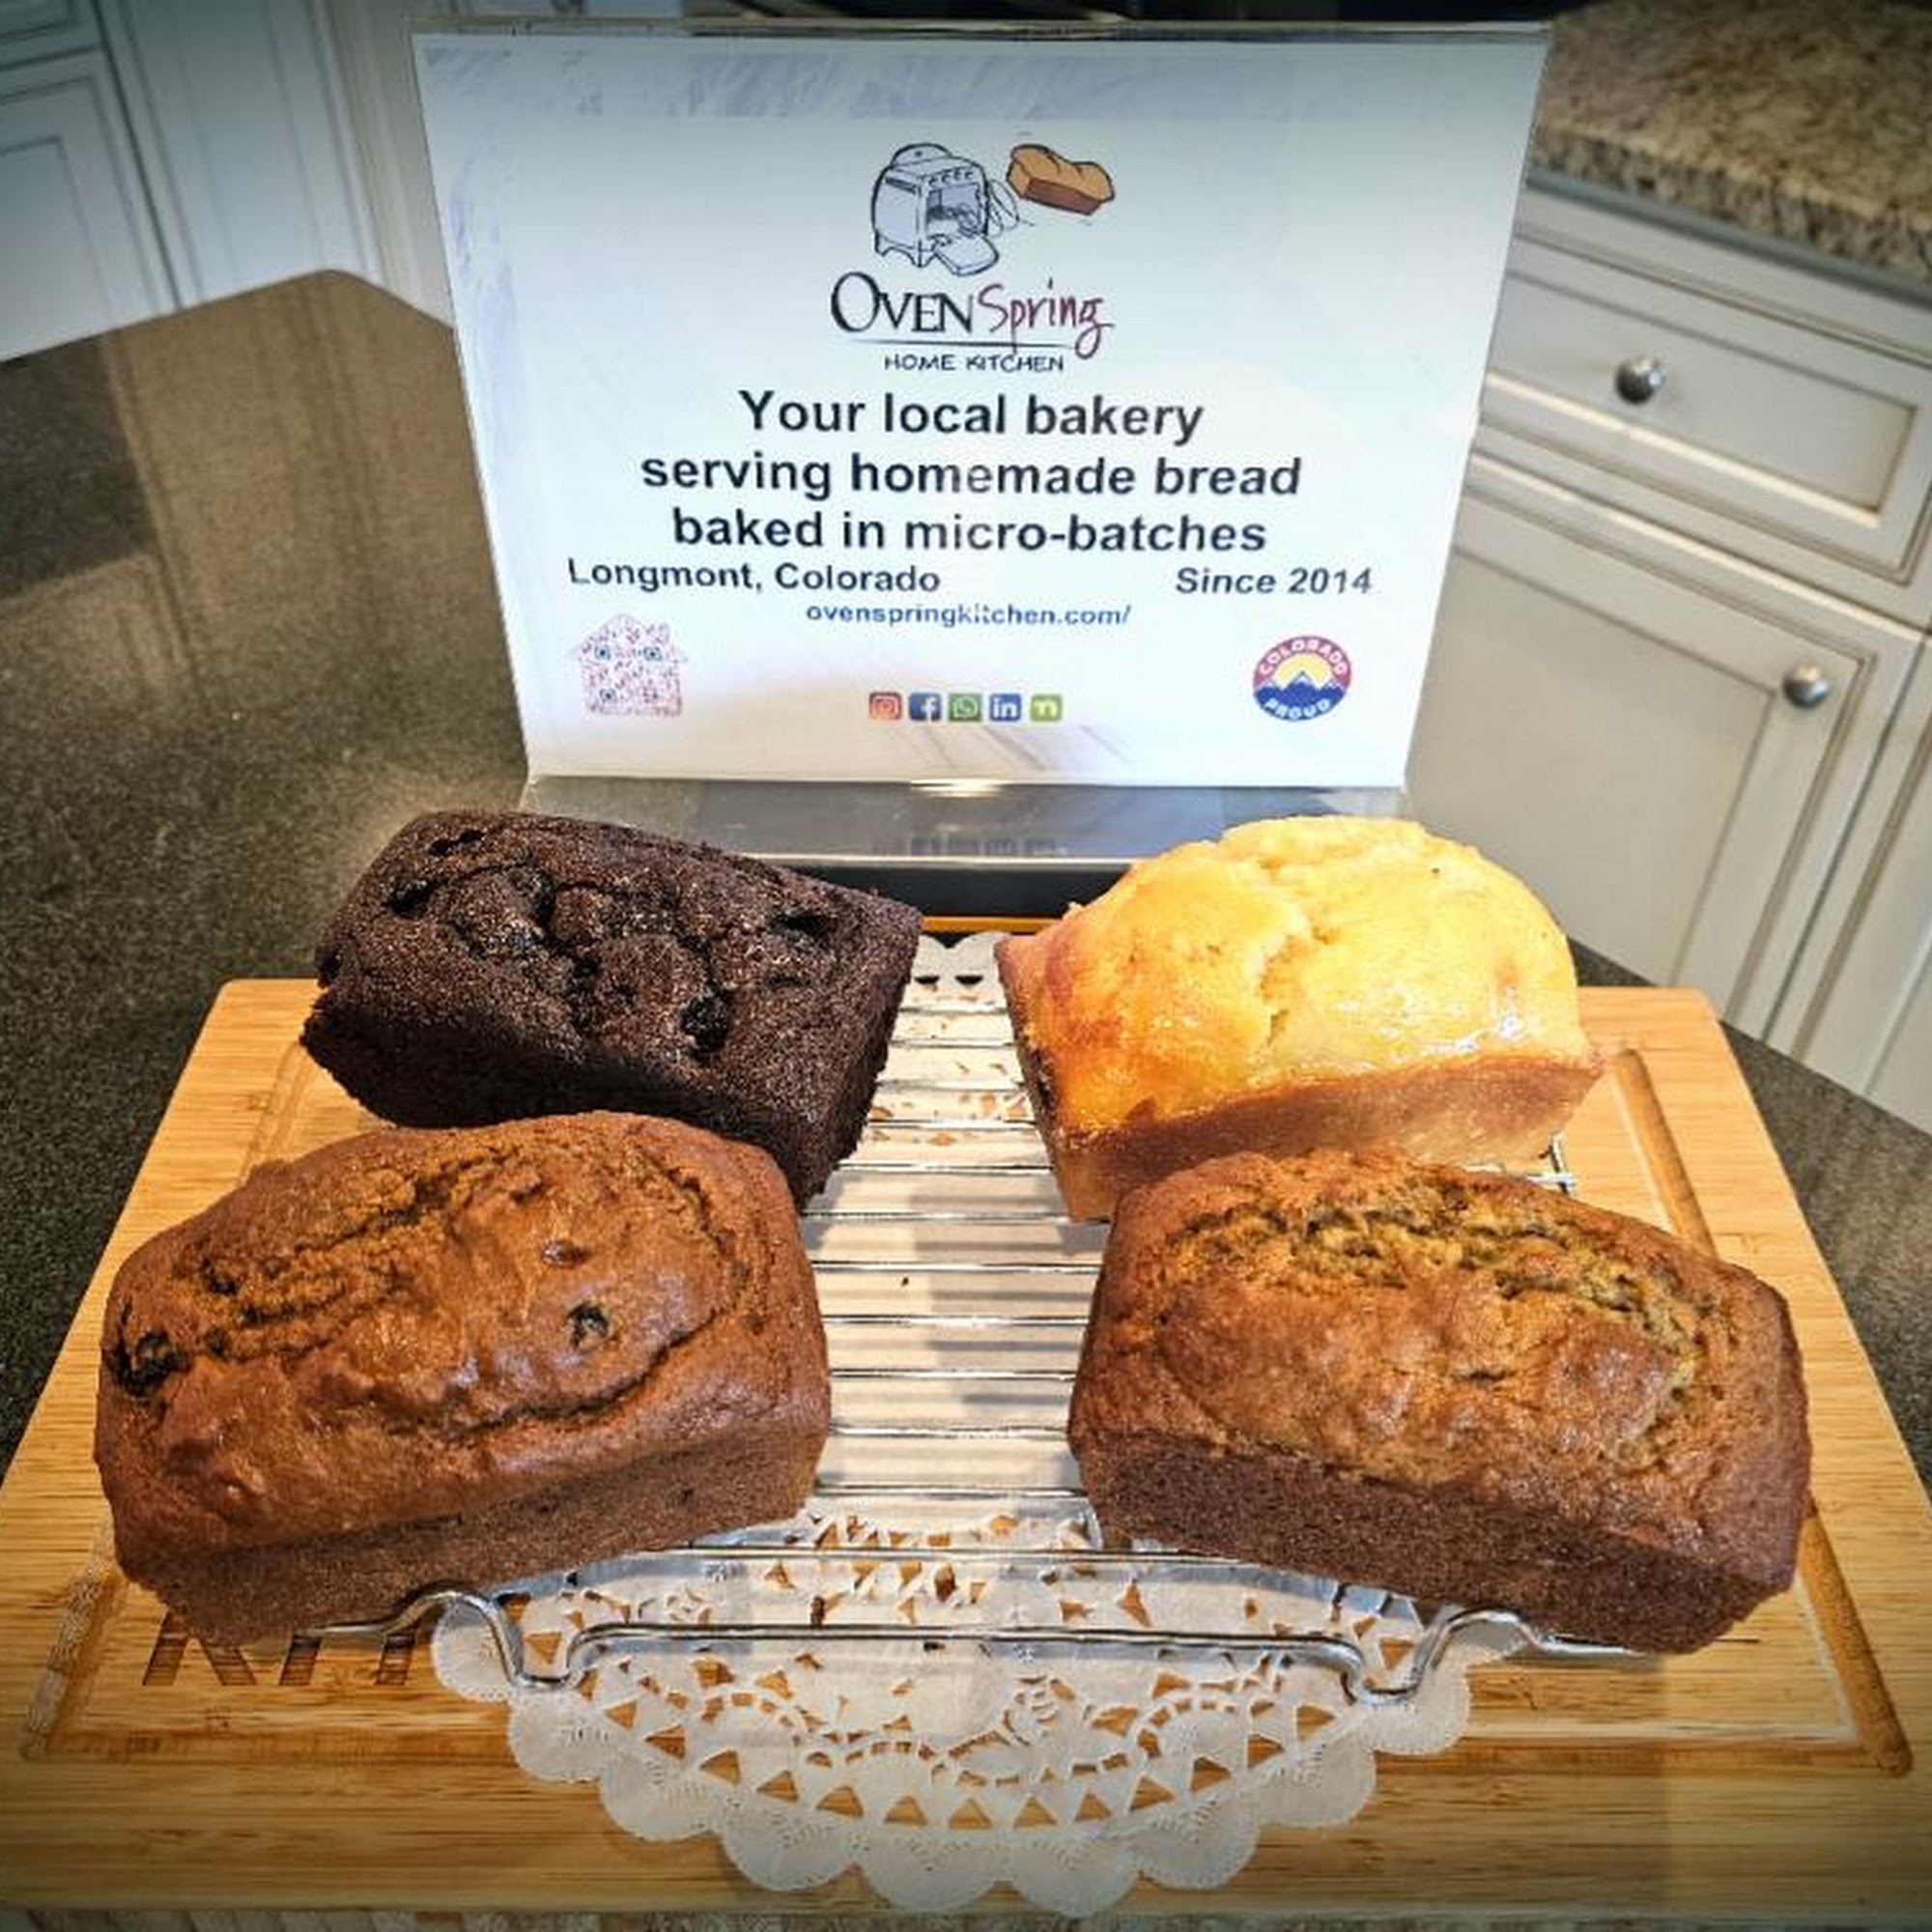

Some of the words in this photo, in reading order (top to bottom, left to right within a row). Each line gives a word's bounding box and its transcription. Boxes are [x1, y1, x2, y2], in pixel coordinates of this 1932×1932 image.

[884, 354, 956, 371] HOME
[965, 352, 1065, 373] KITCHEN
[738, 389, 867, 433] Your
[884, 392, 1006, 435] local
[1026, 393, 1205, 447] bakery
[640, 450, 832, 501] serving
[851, 452, 1137, 496] homemade
[1154, 456, 1302, 496] bread
[672, 506, 824, 548] baked
[843, 510, 885, 550] in
[905, 513, 1267, 552] micro-batches
[568, 557, 763, 594] Longmont,
[774, 561, 941, 592] Colorado
[1176, 566, 1277, 595] Since
[1288, 567, 1373, 595] 2014
[806, 603, 1132, 629] ovenspringkitchen.com/
[1259, 638, 1349, 676] COLORADO
[1265, 697, 1331, 720] PROUD
